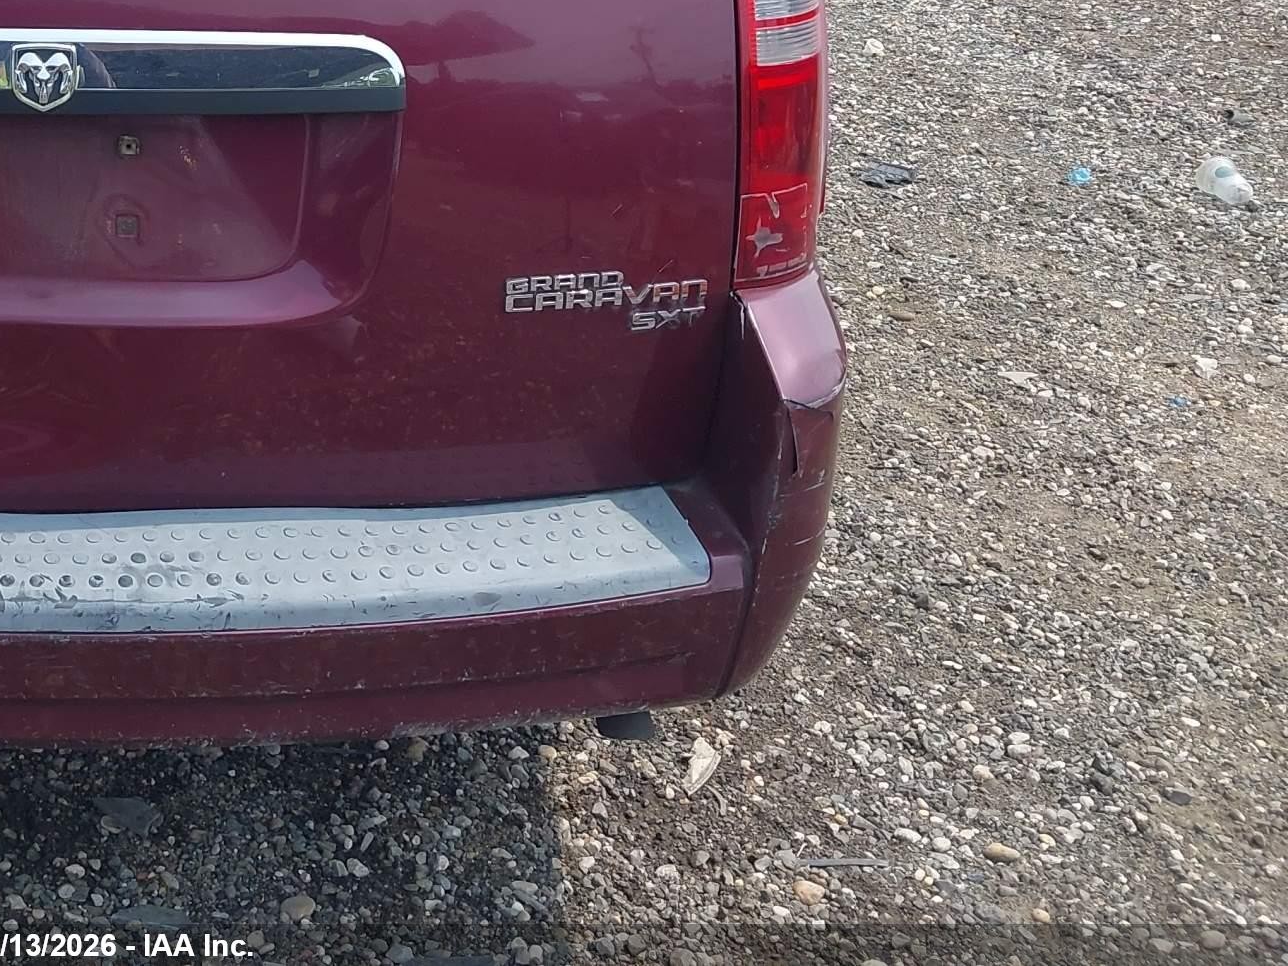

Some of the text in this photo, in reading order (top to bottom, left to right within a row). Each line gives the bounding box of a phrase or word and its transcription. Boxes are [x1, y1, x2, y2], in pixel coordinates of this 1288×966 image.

[505, 270, 624, 295] GRAND
[505, 279, 708, 313] CARAVAN
[631, 305, 706, 331] SXT
